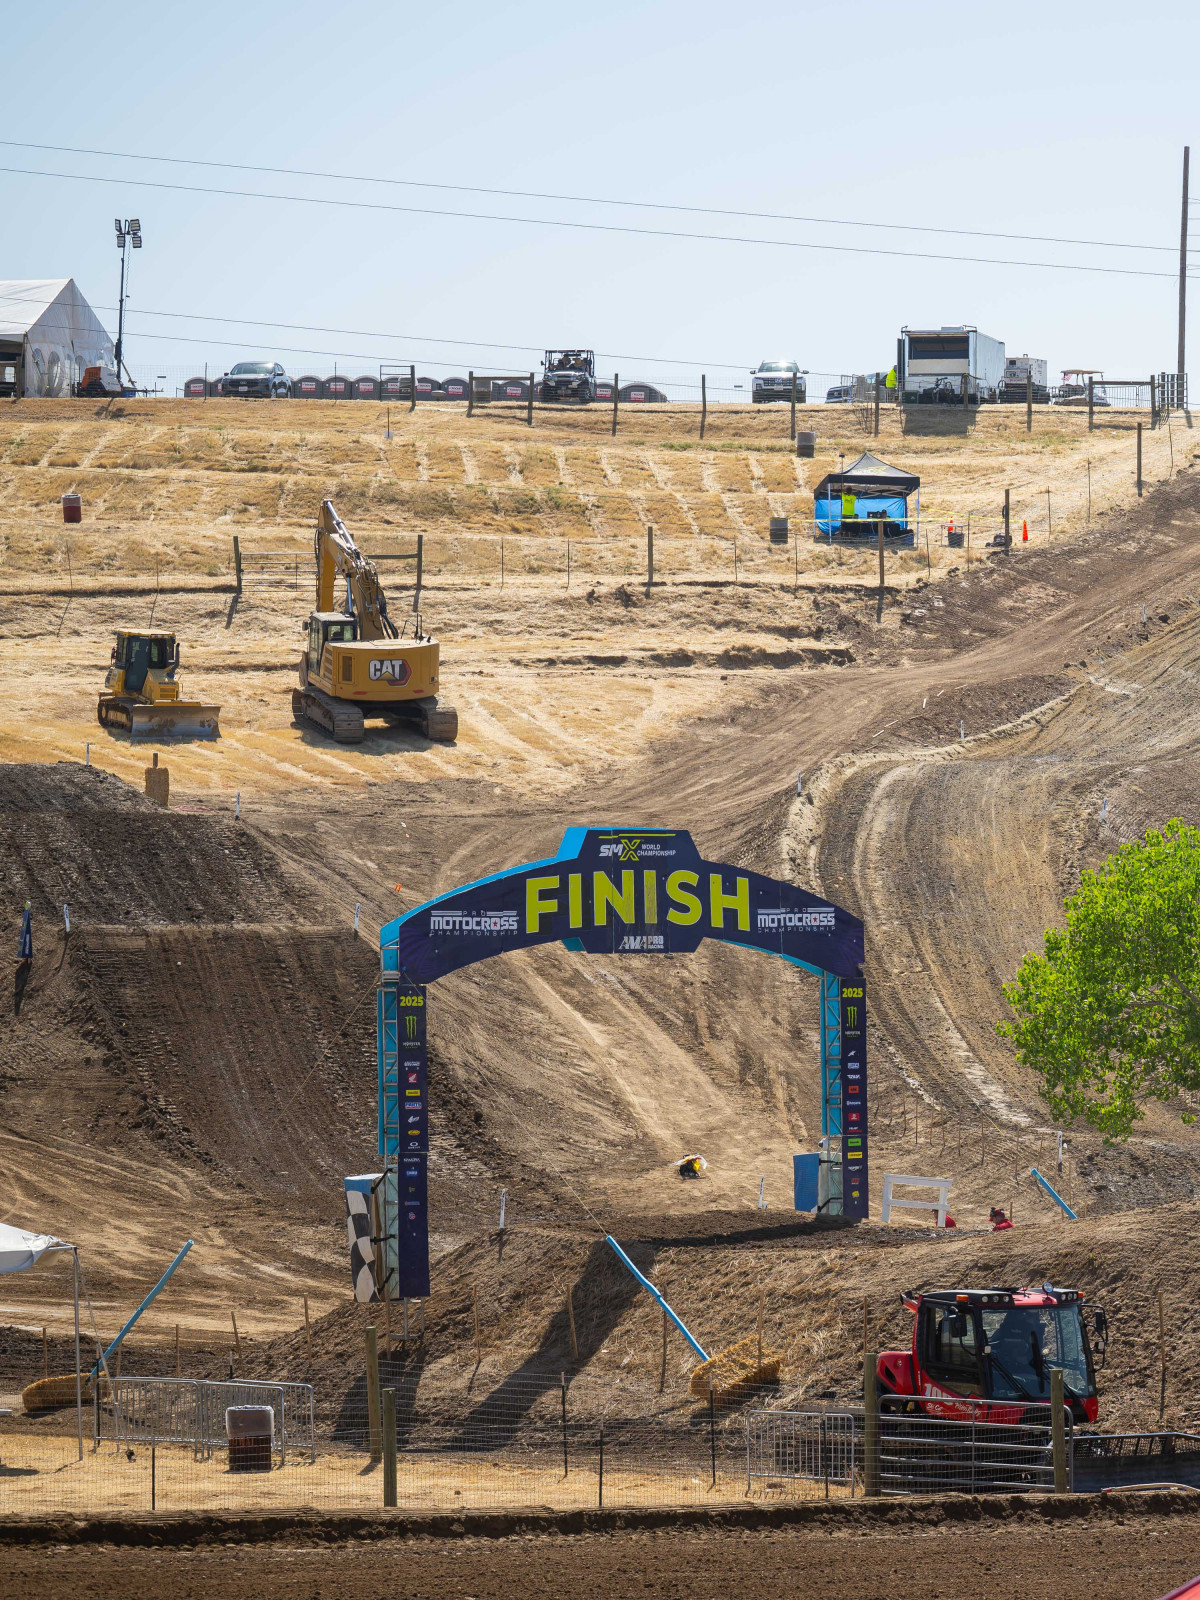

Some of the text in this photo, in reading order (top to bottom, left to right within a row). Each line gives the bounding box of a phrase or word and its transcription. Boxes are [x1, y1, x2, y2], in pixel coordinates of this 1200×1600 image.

[369, 659, 403, 680] CAT
[599, 839, 641, 861] SMX
[636, 849, 677, 857] CHAMPIONSHIP
[525, 869, 751, 934] FINISH
[430, 916, 519, 930] MOTOCROSS
[757, 912, 835, 928] MOTOCROSS
[757, 925, 836, 934] CHAMPIONSHIP
[618, 935, 647, 950] AMA
[647, 935, 664, 945] PRO
[842, 987, 863, 998] 2025
[399, 995, 424, 1007] 2025
